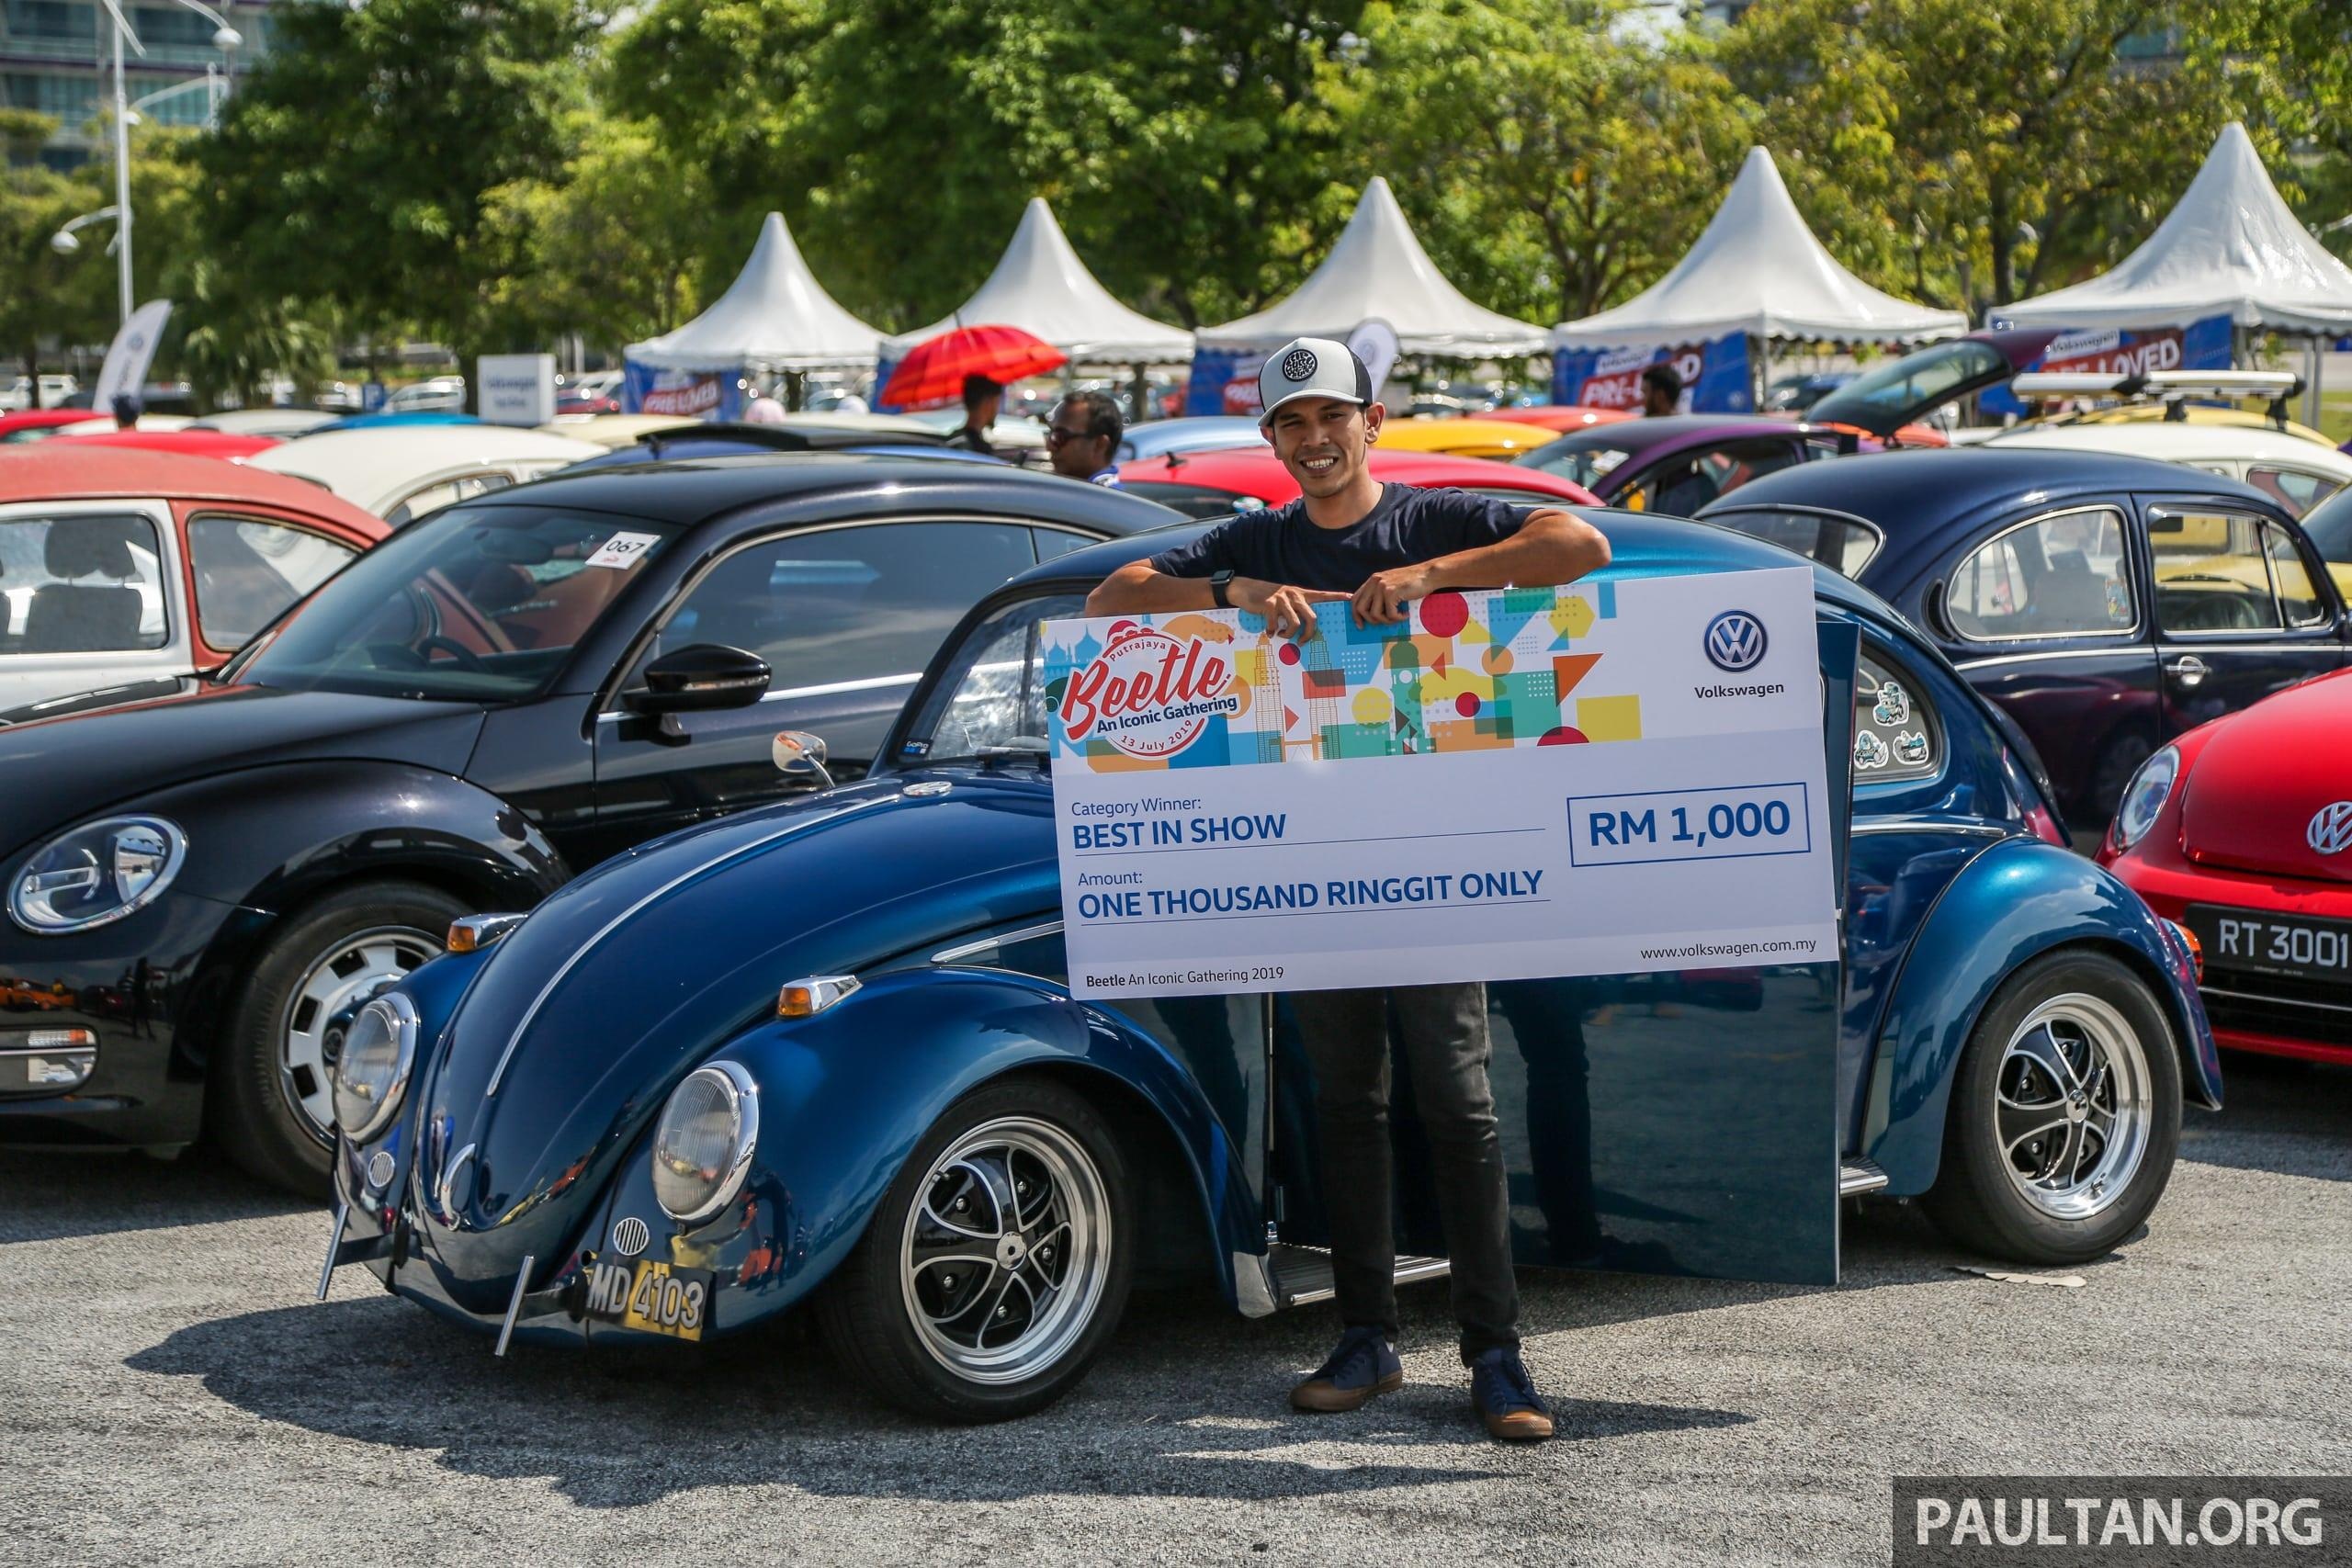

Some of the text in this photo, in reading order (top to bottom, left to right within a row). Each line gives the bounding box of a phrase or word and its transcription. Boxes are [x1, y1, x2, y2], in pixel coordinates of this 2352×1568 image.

[606, 540, 645, 554] 067
[1109, 640, 1166, 661] Putrajaya
[1061, 638, 1231, 740] Beetle
[1694, 684, 1784, 698] Volkswagen
[1097, 697, 1238, 733] An Iconic Gathering
[1121, 719, 1193, 750] 13 July 2019
[1071, 797, 1202, 818] Category Winner:
[1073, 814, 1286, 849] BEST IN SHOW
[1589, 800, 1790, 847] RM 1,000
[1078, 872, 1143, 886] Amount:
[1078, 870, 1544, 919] ONE THOUSAND RINGGIT ONLY
[1641, 939, 1816, 959] www.volkswagen.com.my
[2219, 919, 2348, 968] RT 3001
[1086, 967, 1283, 987] Beetle An Iconic Gathering 2019
[587, 1262, 704, 1329] MD 4103
